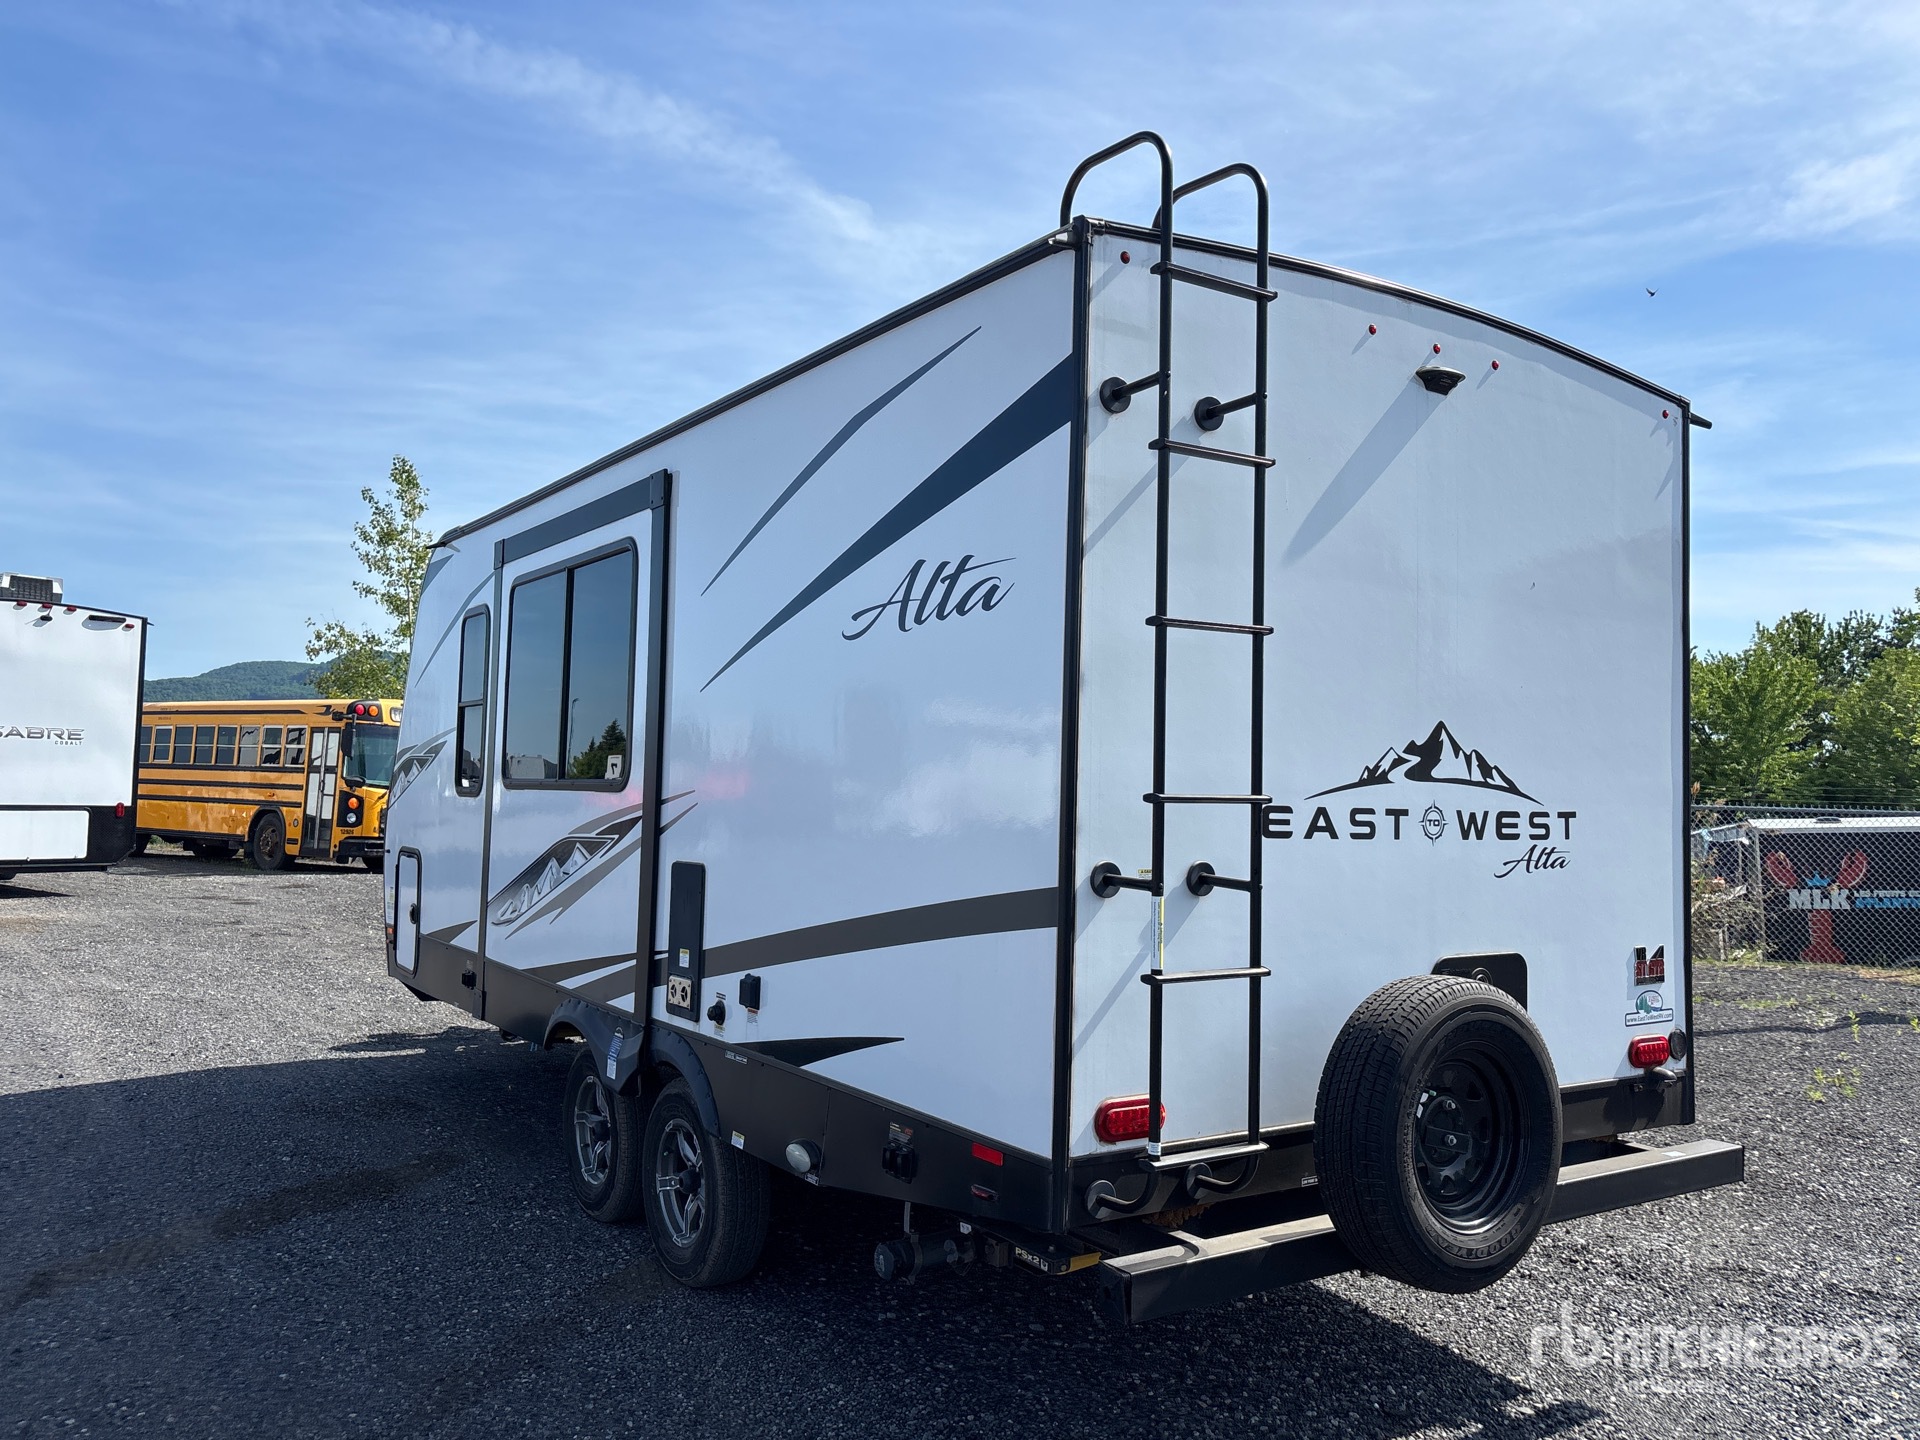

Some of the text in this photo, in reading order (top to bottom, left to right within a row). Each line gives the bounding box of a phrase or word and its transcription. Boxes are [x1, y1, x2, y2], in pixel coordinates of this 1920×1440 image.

[842, 554, 1016, 641] Alta
[1261, 805, 1577, 841] EAST TO WEST
[1494, 844, 1571, 879] Alta
[1788, 888, 1850, 910] MLK
